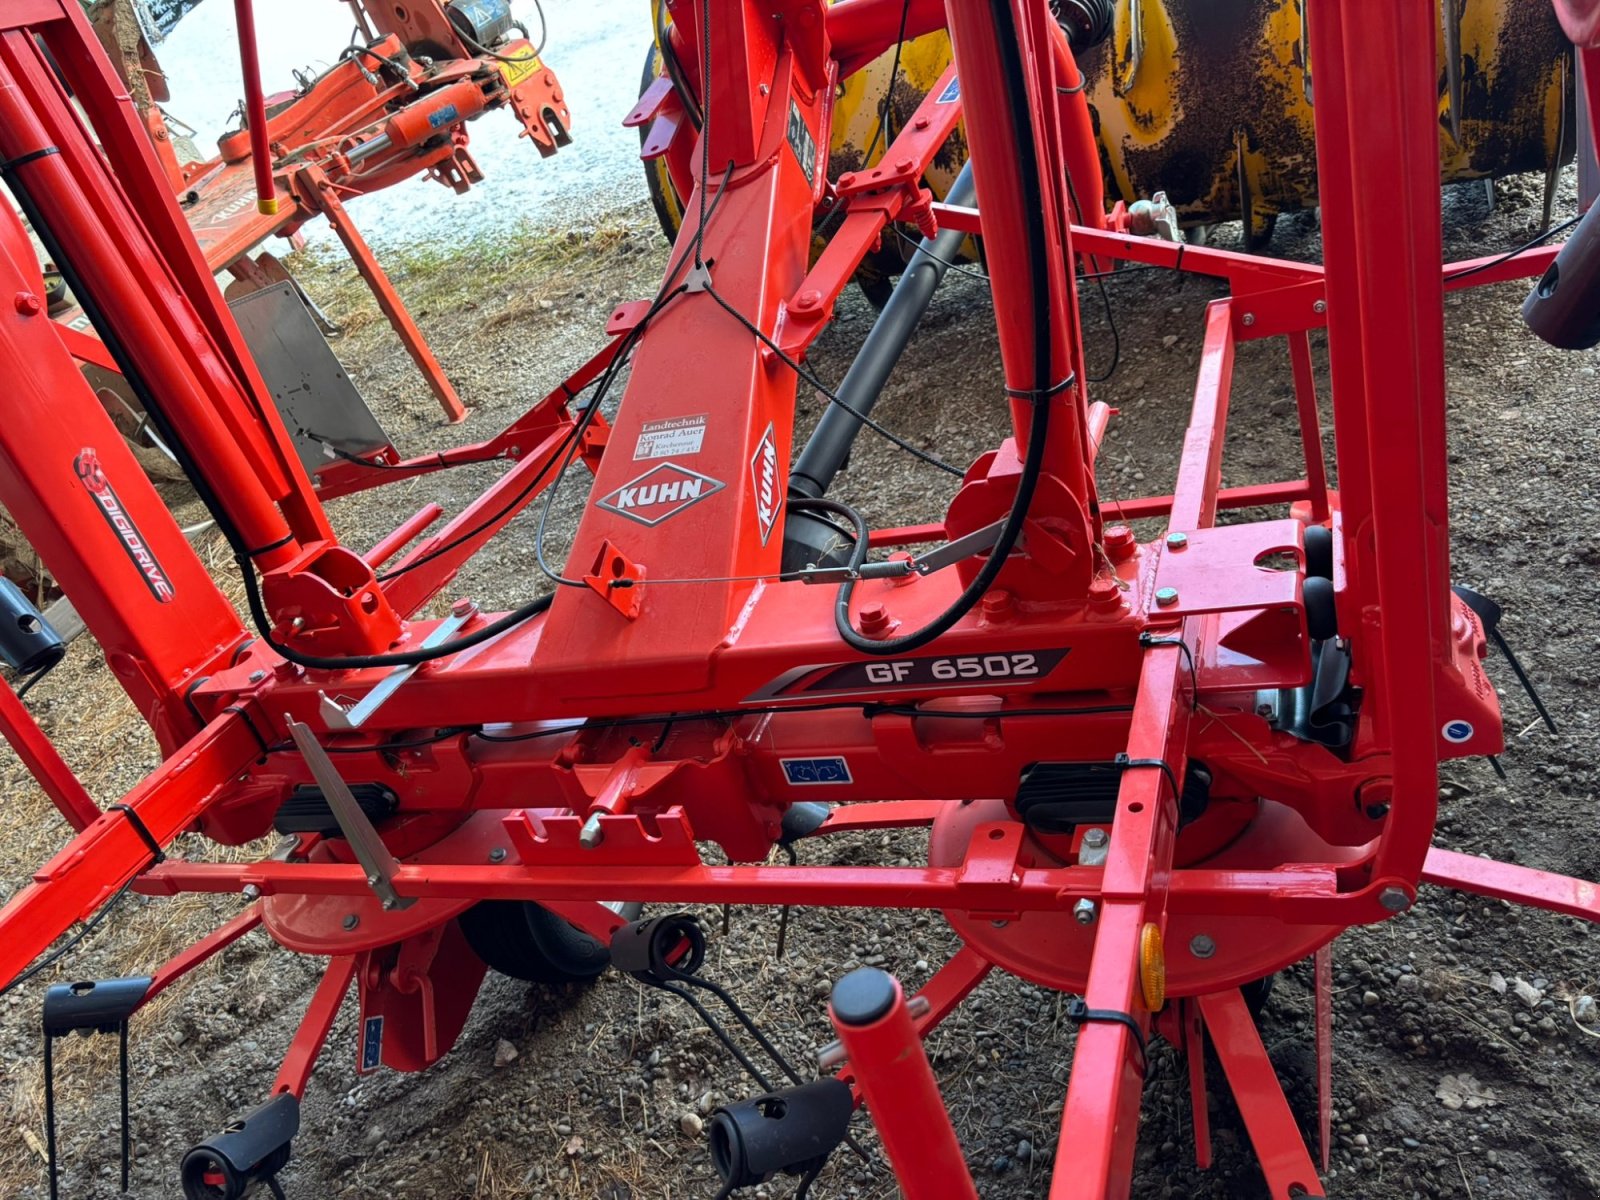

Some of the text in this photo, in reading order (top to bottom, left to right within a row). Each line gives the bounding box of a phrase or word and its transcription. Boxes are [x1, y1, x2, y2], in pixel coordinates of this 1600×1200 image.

[219, 188, 258, 220] KUHN
[640, 428, 703, 442] Konrad Auer
[642, 416, 706, 432] Landtechnik
[617, 479, 702, 509] KUHN
[760, 438, 775, 528] KUHN
[100, 489, 172, 597] DIGIDRIVE
[865, 654, 1039, 683] GF 6502
